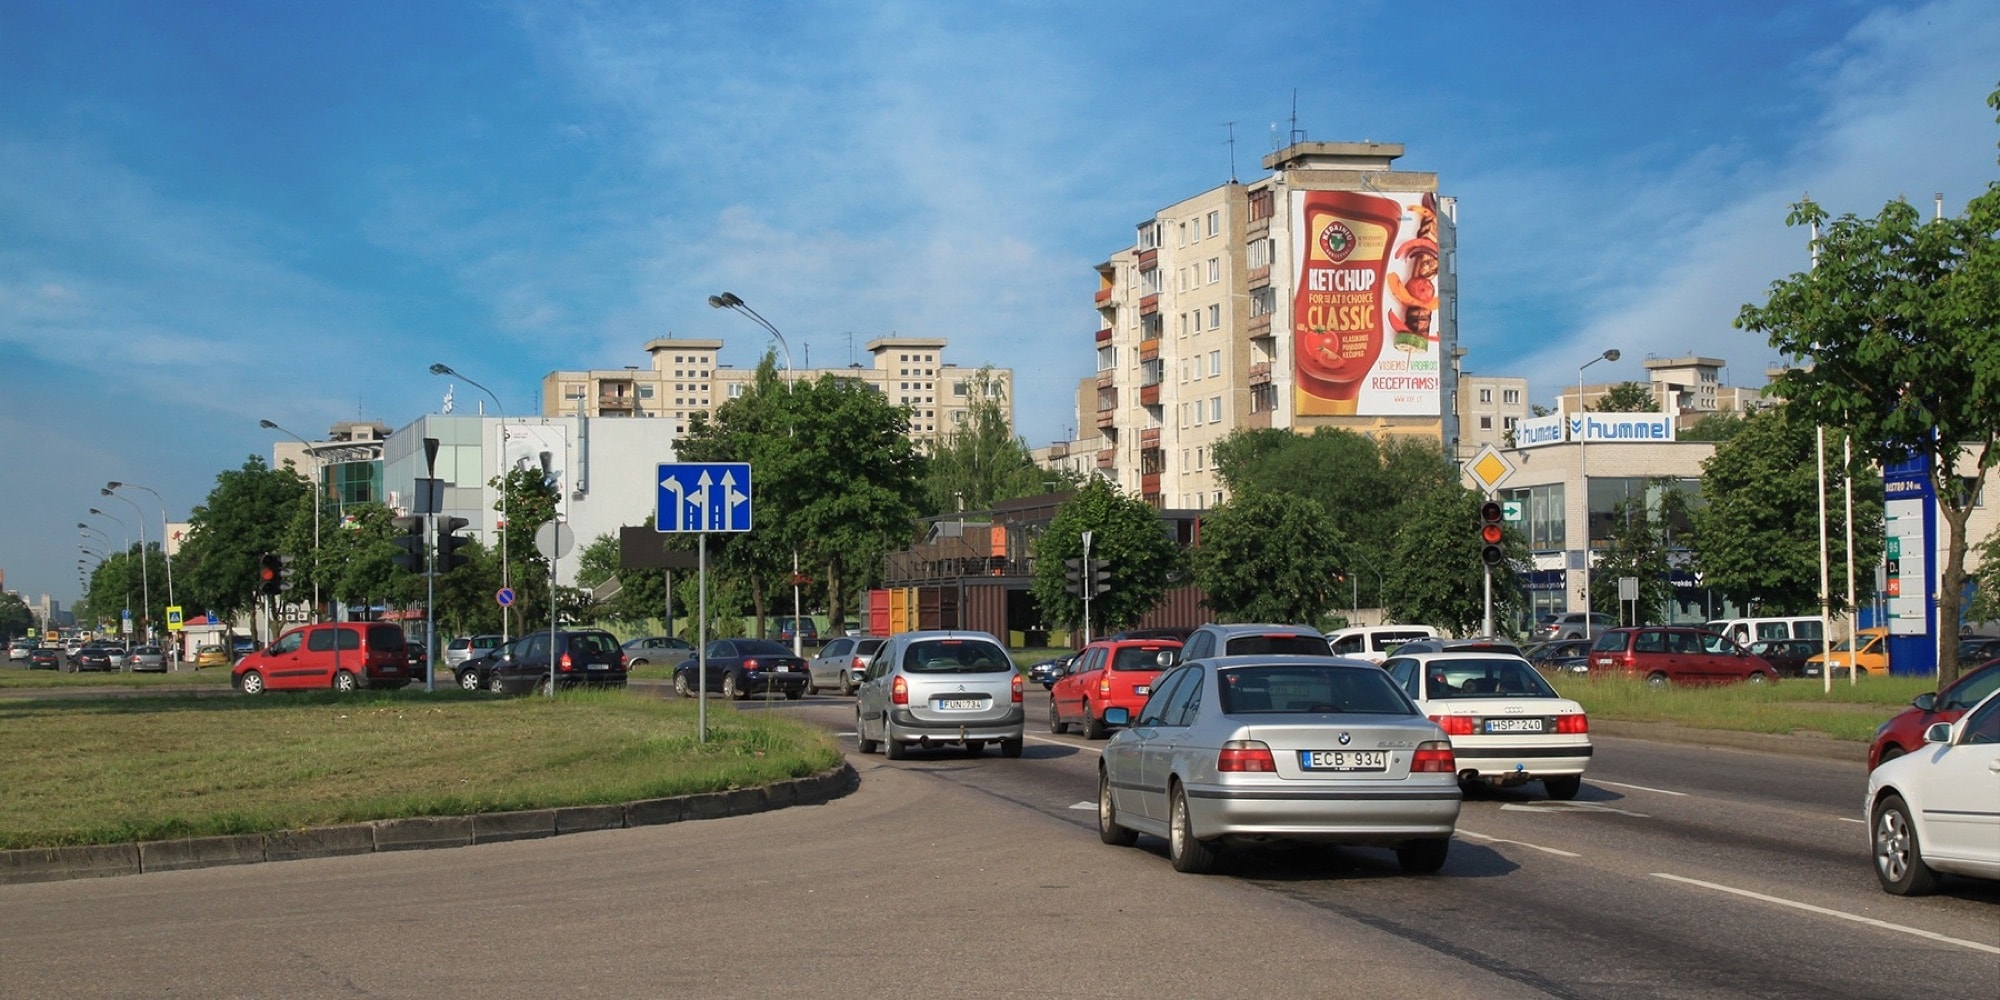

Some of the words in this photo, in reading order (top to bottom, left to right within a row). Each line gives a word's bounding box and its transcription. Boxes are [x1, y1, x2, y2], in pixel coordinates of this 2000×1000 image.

[1308, 268, 1376, 292] KETCHUP
[1308, 293, 1324, 304] FOR
[1346, 292, 1374, 304] CHOICE
[1307, 304, 1375, 331] CLASSIC
[1372, 377, 1439, 390] RECEPTAMS!
[1523, 417, 1562, 444] hummel
[1587, 416, 1670, 439] hummel
[1888, 541, 1899, 553] 95
[944, 700, 962, 708] FUN
[966, 700, 981, 708] 734
[1492, 720, 1515, 730] HSP
[1521, 720, 1541, 730] 240
[1312, 752, 1345, 766] ECB
[1354, 752, 1382, 766] 934
